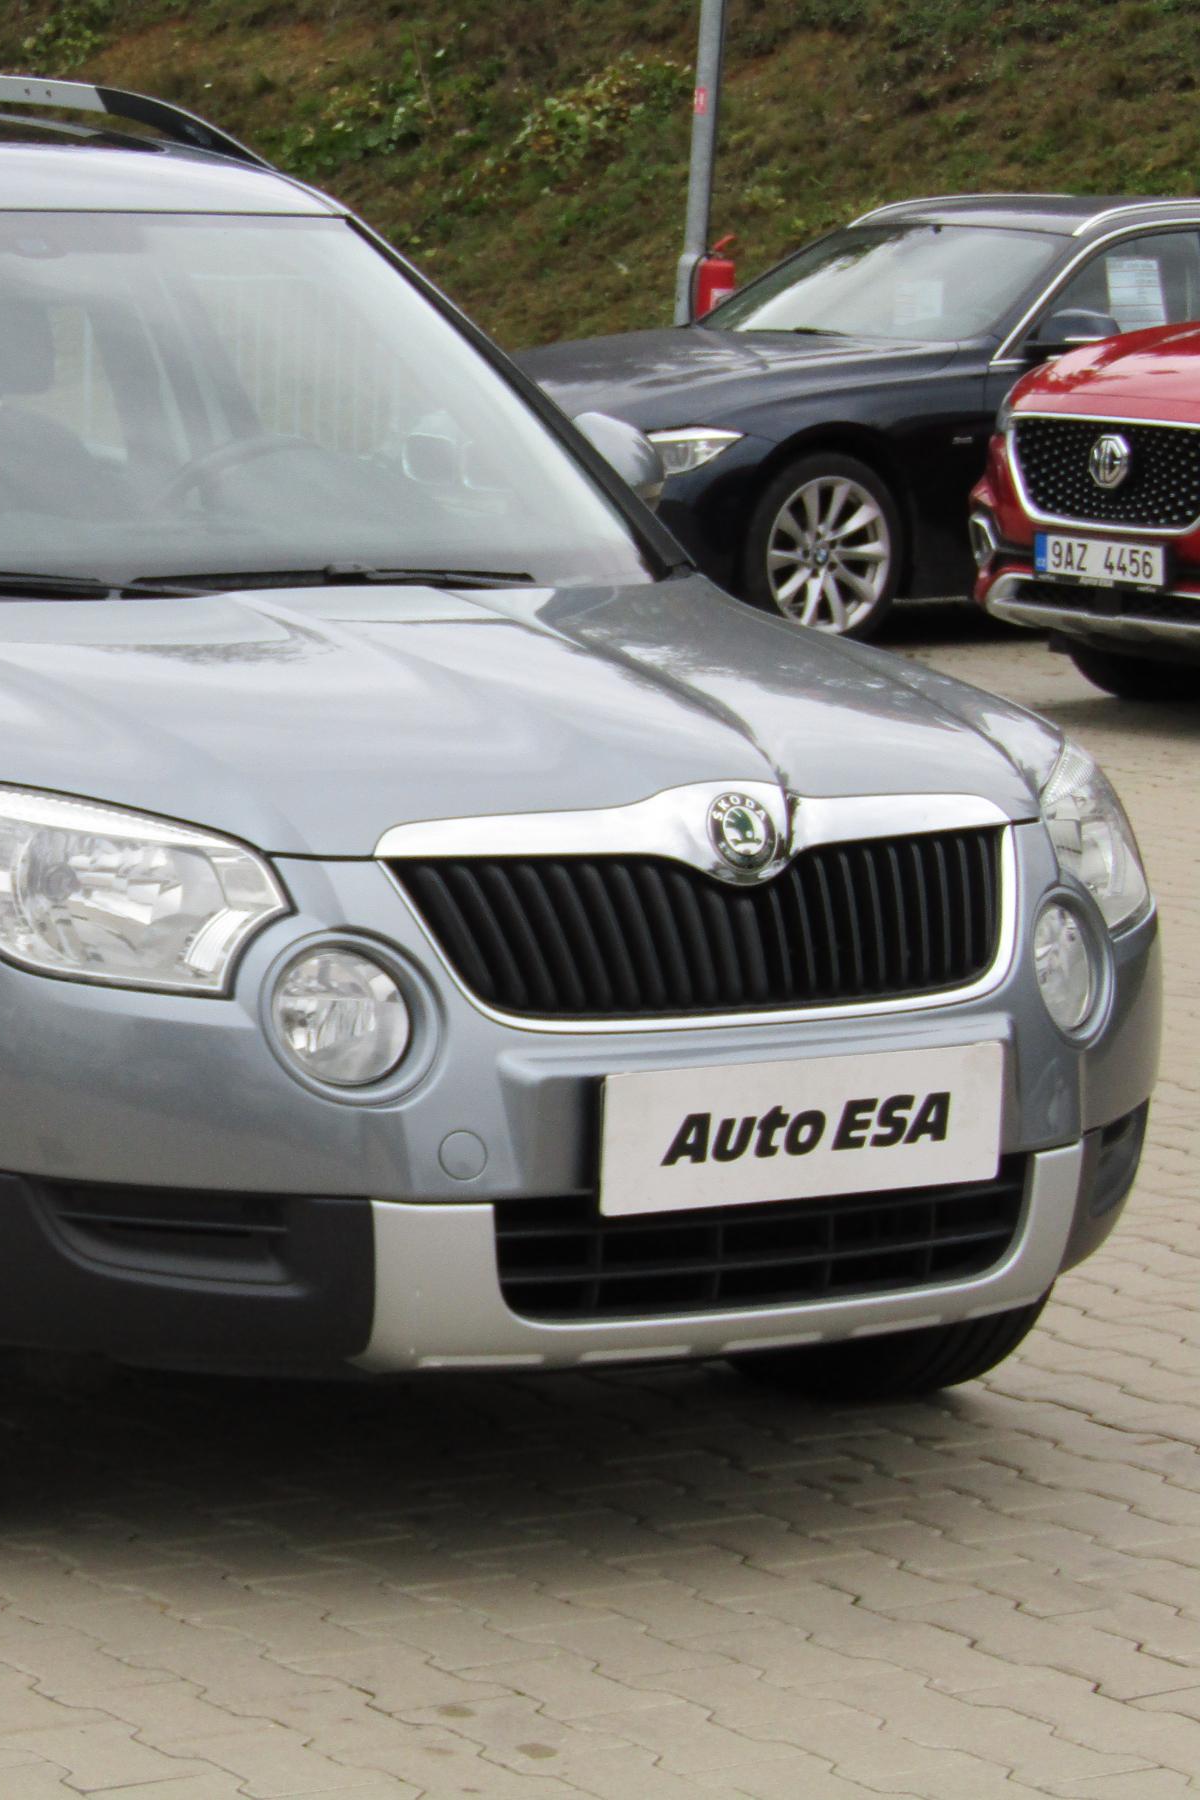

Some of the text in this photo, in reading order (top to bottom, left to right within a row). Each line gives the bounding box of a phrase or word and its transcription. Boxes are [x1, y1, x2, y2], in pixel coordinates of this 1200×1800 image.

[1051, 540, 1154, 580] 9AZ 4456
[660, 1091, 952, 1167] Auto ESA
